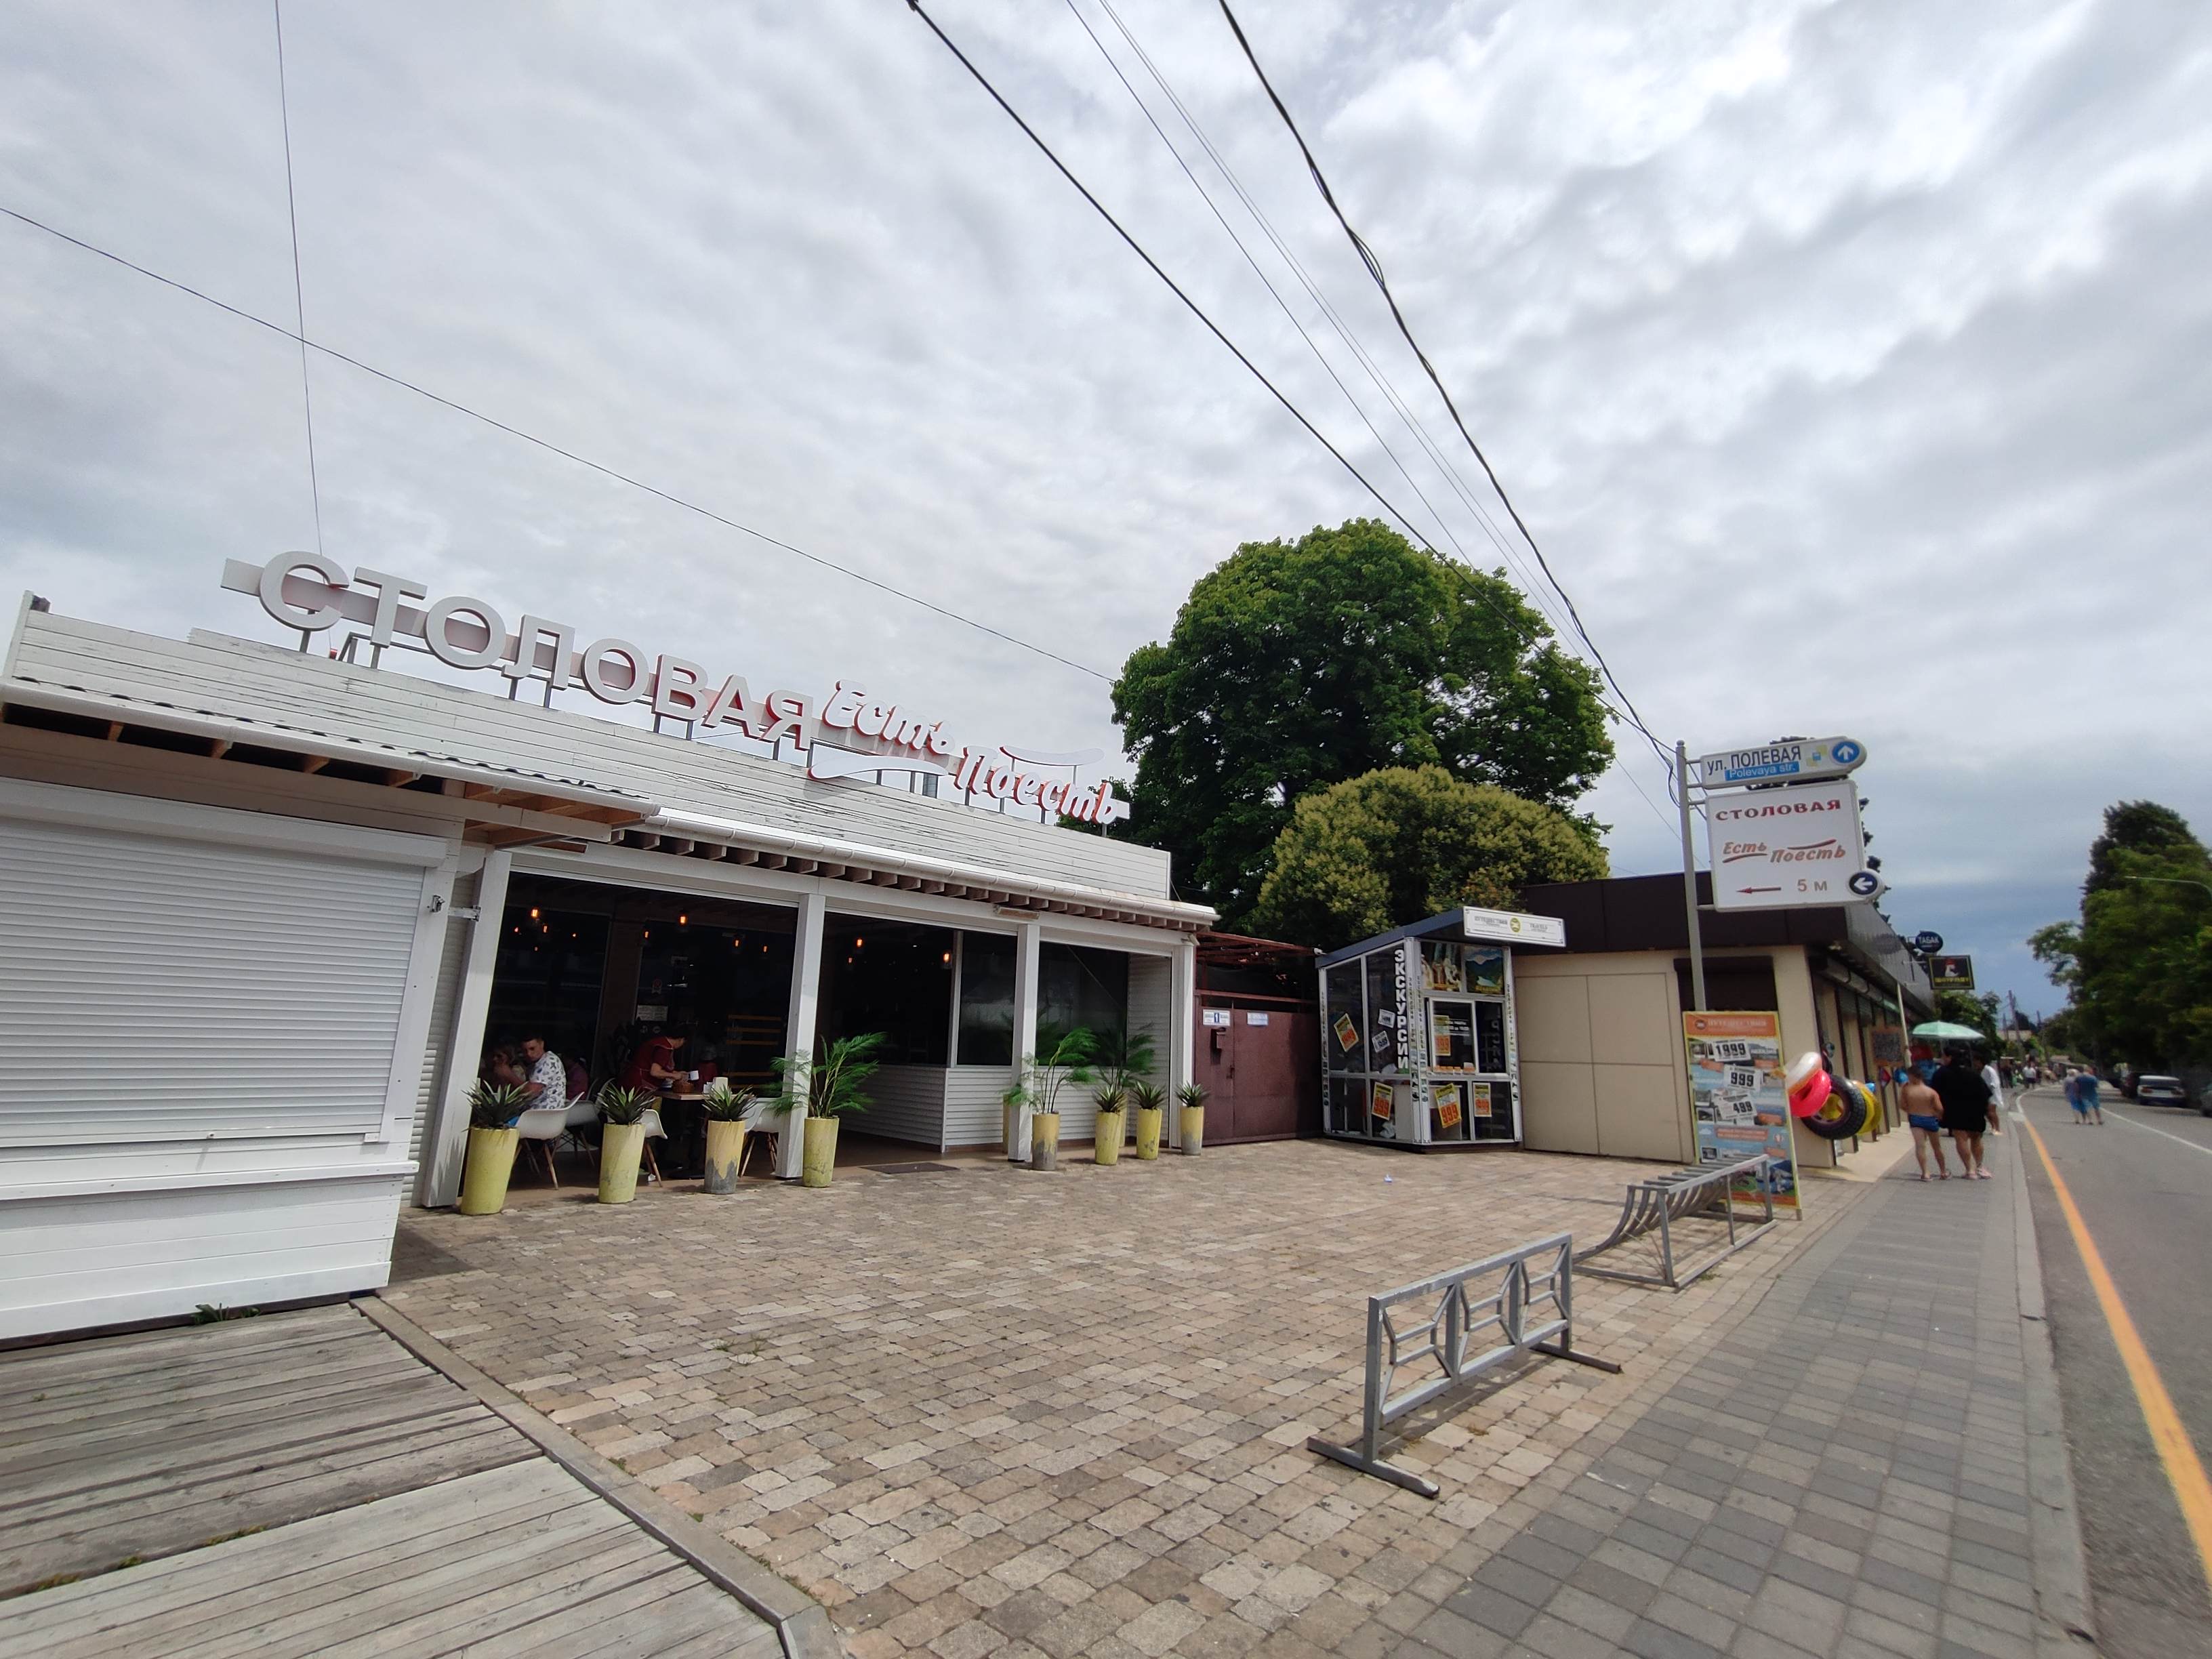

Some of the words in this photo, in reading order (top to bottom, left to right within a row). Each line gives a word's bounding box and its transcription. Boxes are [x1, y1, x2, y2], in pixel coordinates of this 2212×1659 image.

[259, 550, 813, 750] СТОЛОВАЯ
[821, 679, 956, 755] Есть
[953, 745, 1118, 825] Поесть
[1707, 760, 1726, 775] ул.
[1731, 745, 1801, 769] ПОЛЕВАЯ
[1729, 766, 1777, 778] Polevaya
[1779, 763, 1795, 773] str.
[1715, 799, 1841, 821] СТОЛОВАЯ
[1723, 841, 1768, 855] Есть
[1769, 845, 1846, 863] Поесть
[1797, 879, 1807, 892] 5
[1394, 949, 1408, 1069] ЭКСКУРСИИ
[1716, 1043, 1746, 1056] 1999
[1730, 1071, 1754, 1087] 999
[1441, 1103, 1458, 1124] 999
